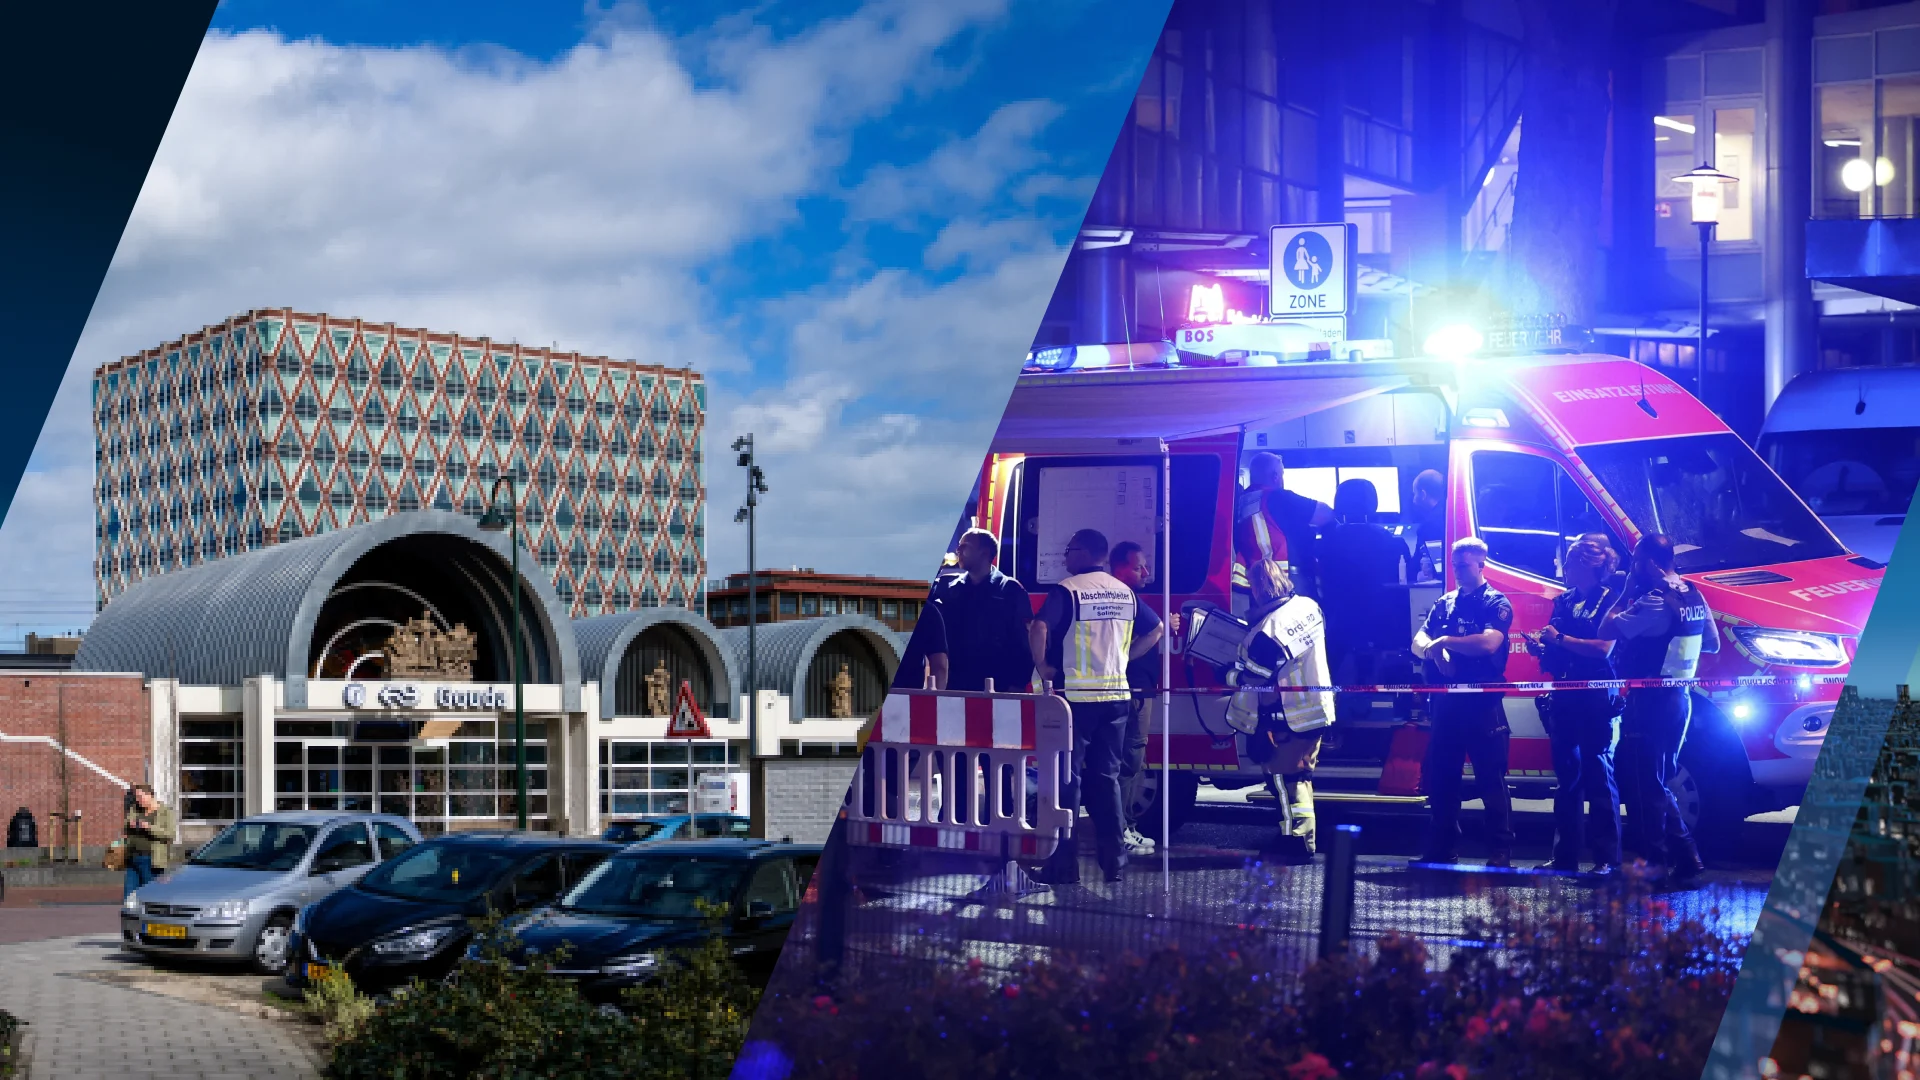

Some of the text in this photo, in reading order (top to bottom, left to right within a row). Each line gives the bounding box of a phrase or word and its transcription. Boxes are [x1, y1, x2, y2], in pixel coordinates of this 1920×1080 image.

[1289, 294, 1327, 309] ZONE
[1185, 330, 1214, 343] BOS
[1488, 329, 1562, 348] FEUERWEHR
[1552, 383, 1682, 403] EINSATZLEITUNG
[1296, 440, 1305, 448] 12
[436, 686, 509, 707] Gouda
